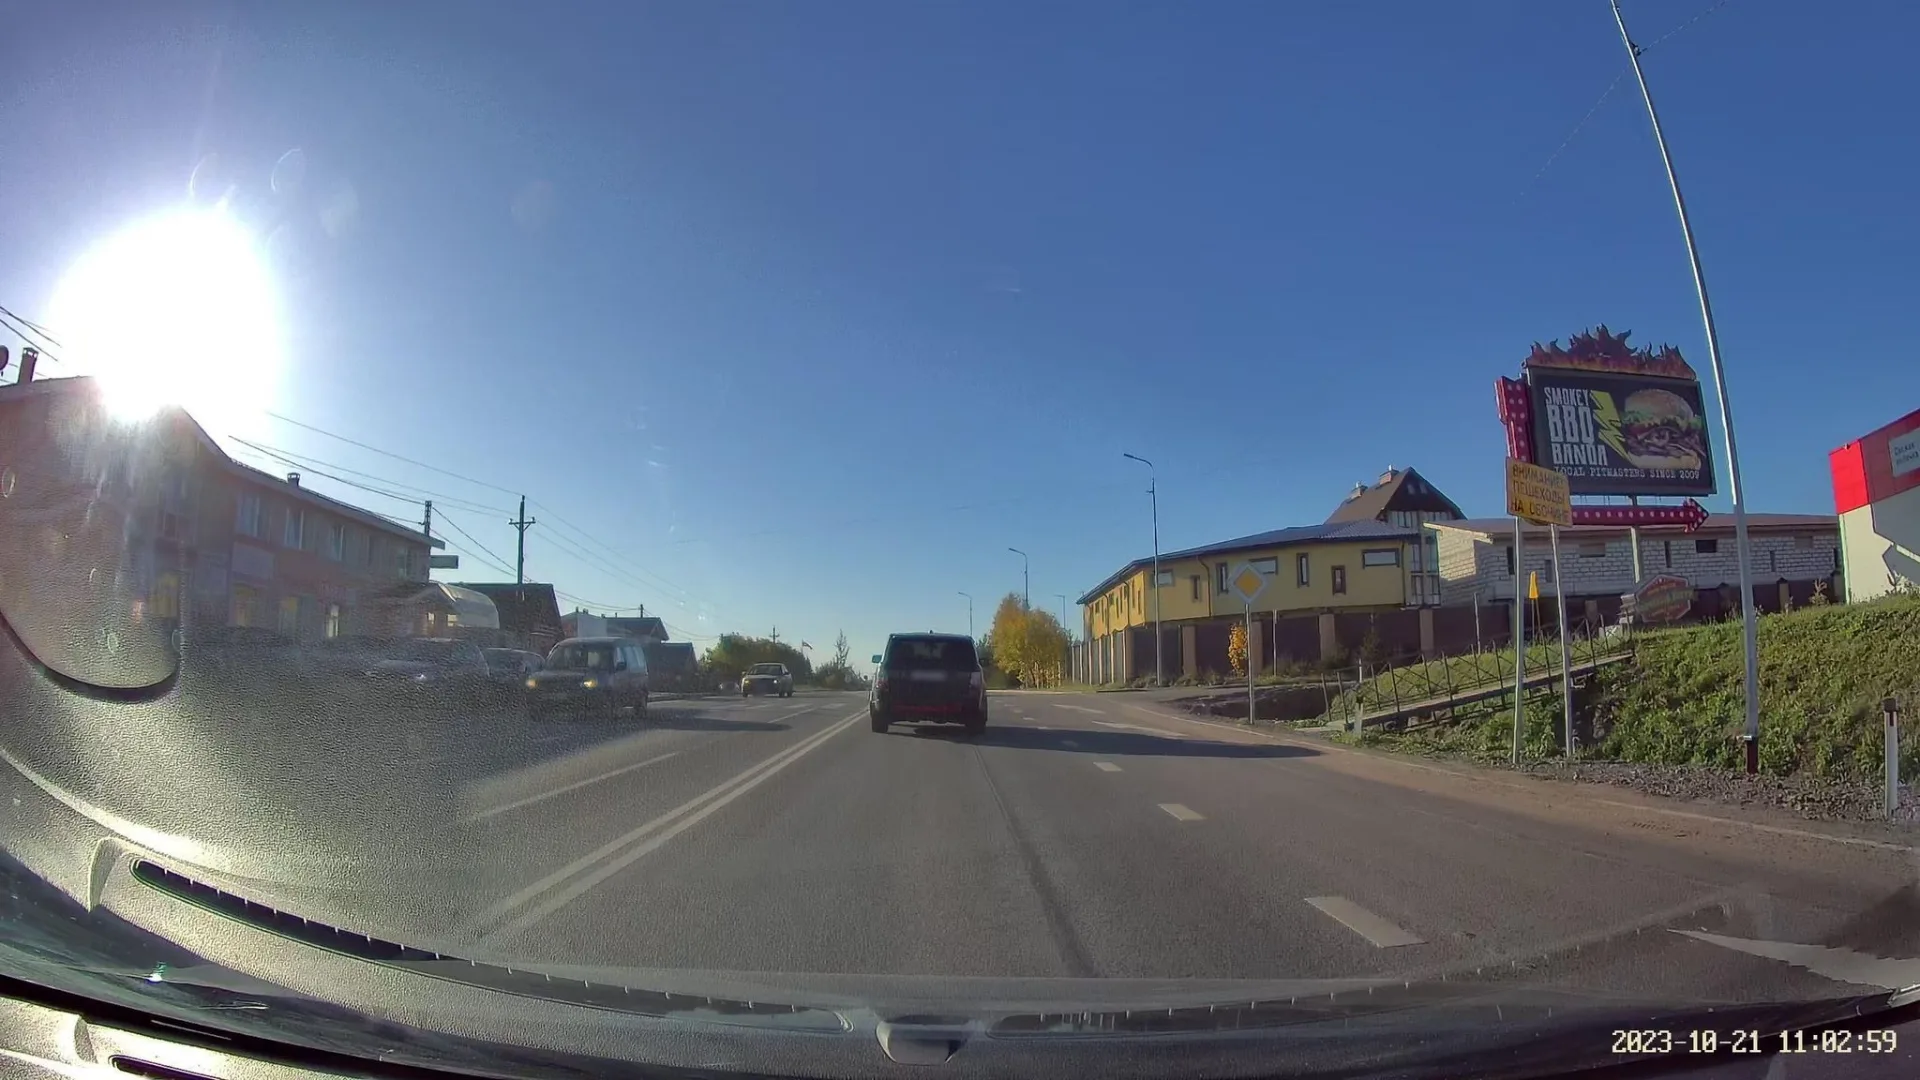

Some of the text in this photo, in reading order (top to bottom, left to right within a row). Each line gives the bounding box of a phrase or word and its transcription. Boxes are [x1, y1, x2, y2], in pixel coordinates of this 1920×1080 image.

[1543, 387, 1590, 406] SMOKEY
[1547, 404, 1594, 445] BBQ
[1552, 444, 1608, 466] BANDA
[1554, 466, 1700, 480] LOCAL PITMASTERS SINCE 2009
[1513, 480, 1566, 504] ПЕШЕХОДЫ
[1510, 497, 1525, 513] НА
